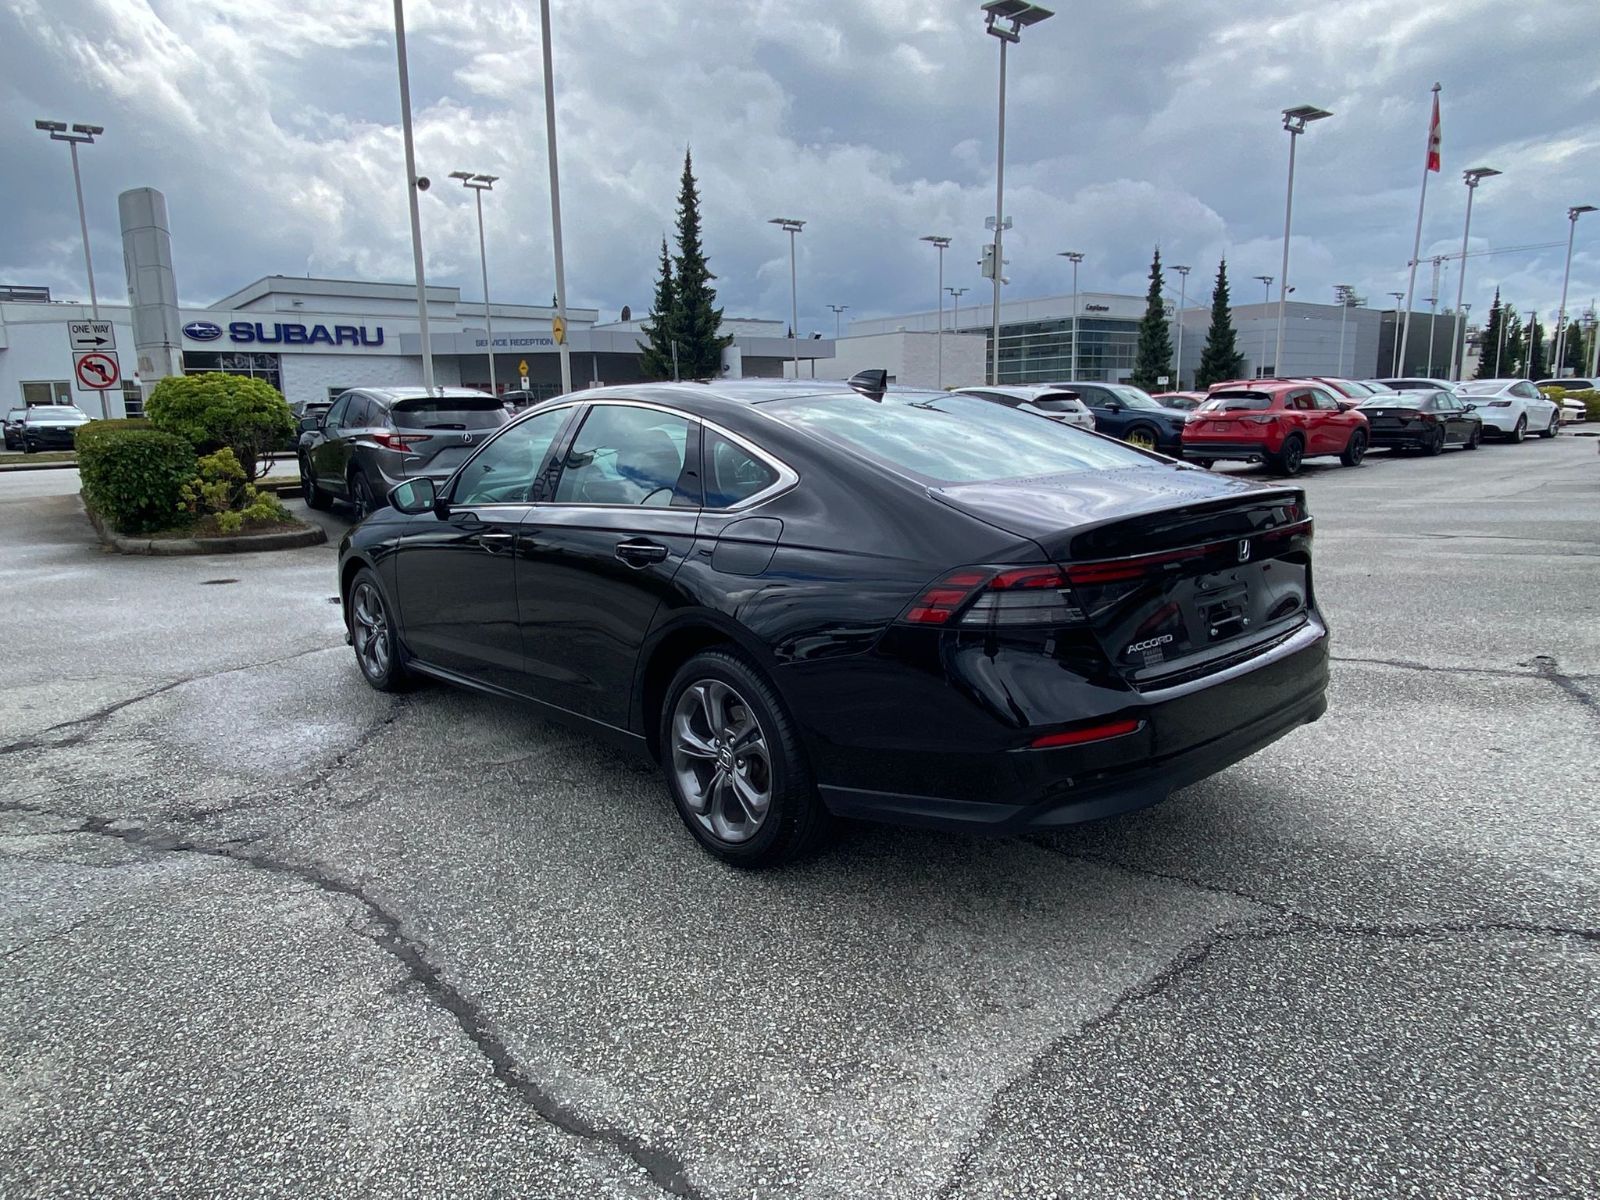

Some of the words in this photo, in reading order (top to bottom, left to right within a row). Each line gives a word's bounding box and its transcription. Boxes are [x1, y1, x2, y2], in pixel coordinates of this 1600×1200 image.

[72, 325, 90, 333] ONE
[93, 325, 109, 333] WAY
[229, 322, 384, 346] SUBARU
[510, 338, 554, 347] RECEPTION
[1127, 634, 1173, 655] ACCORD
